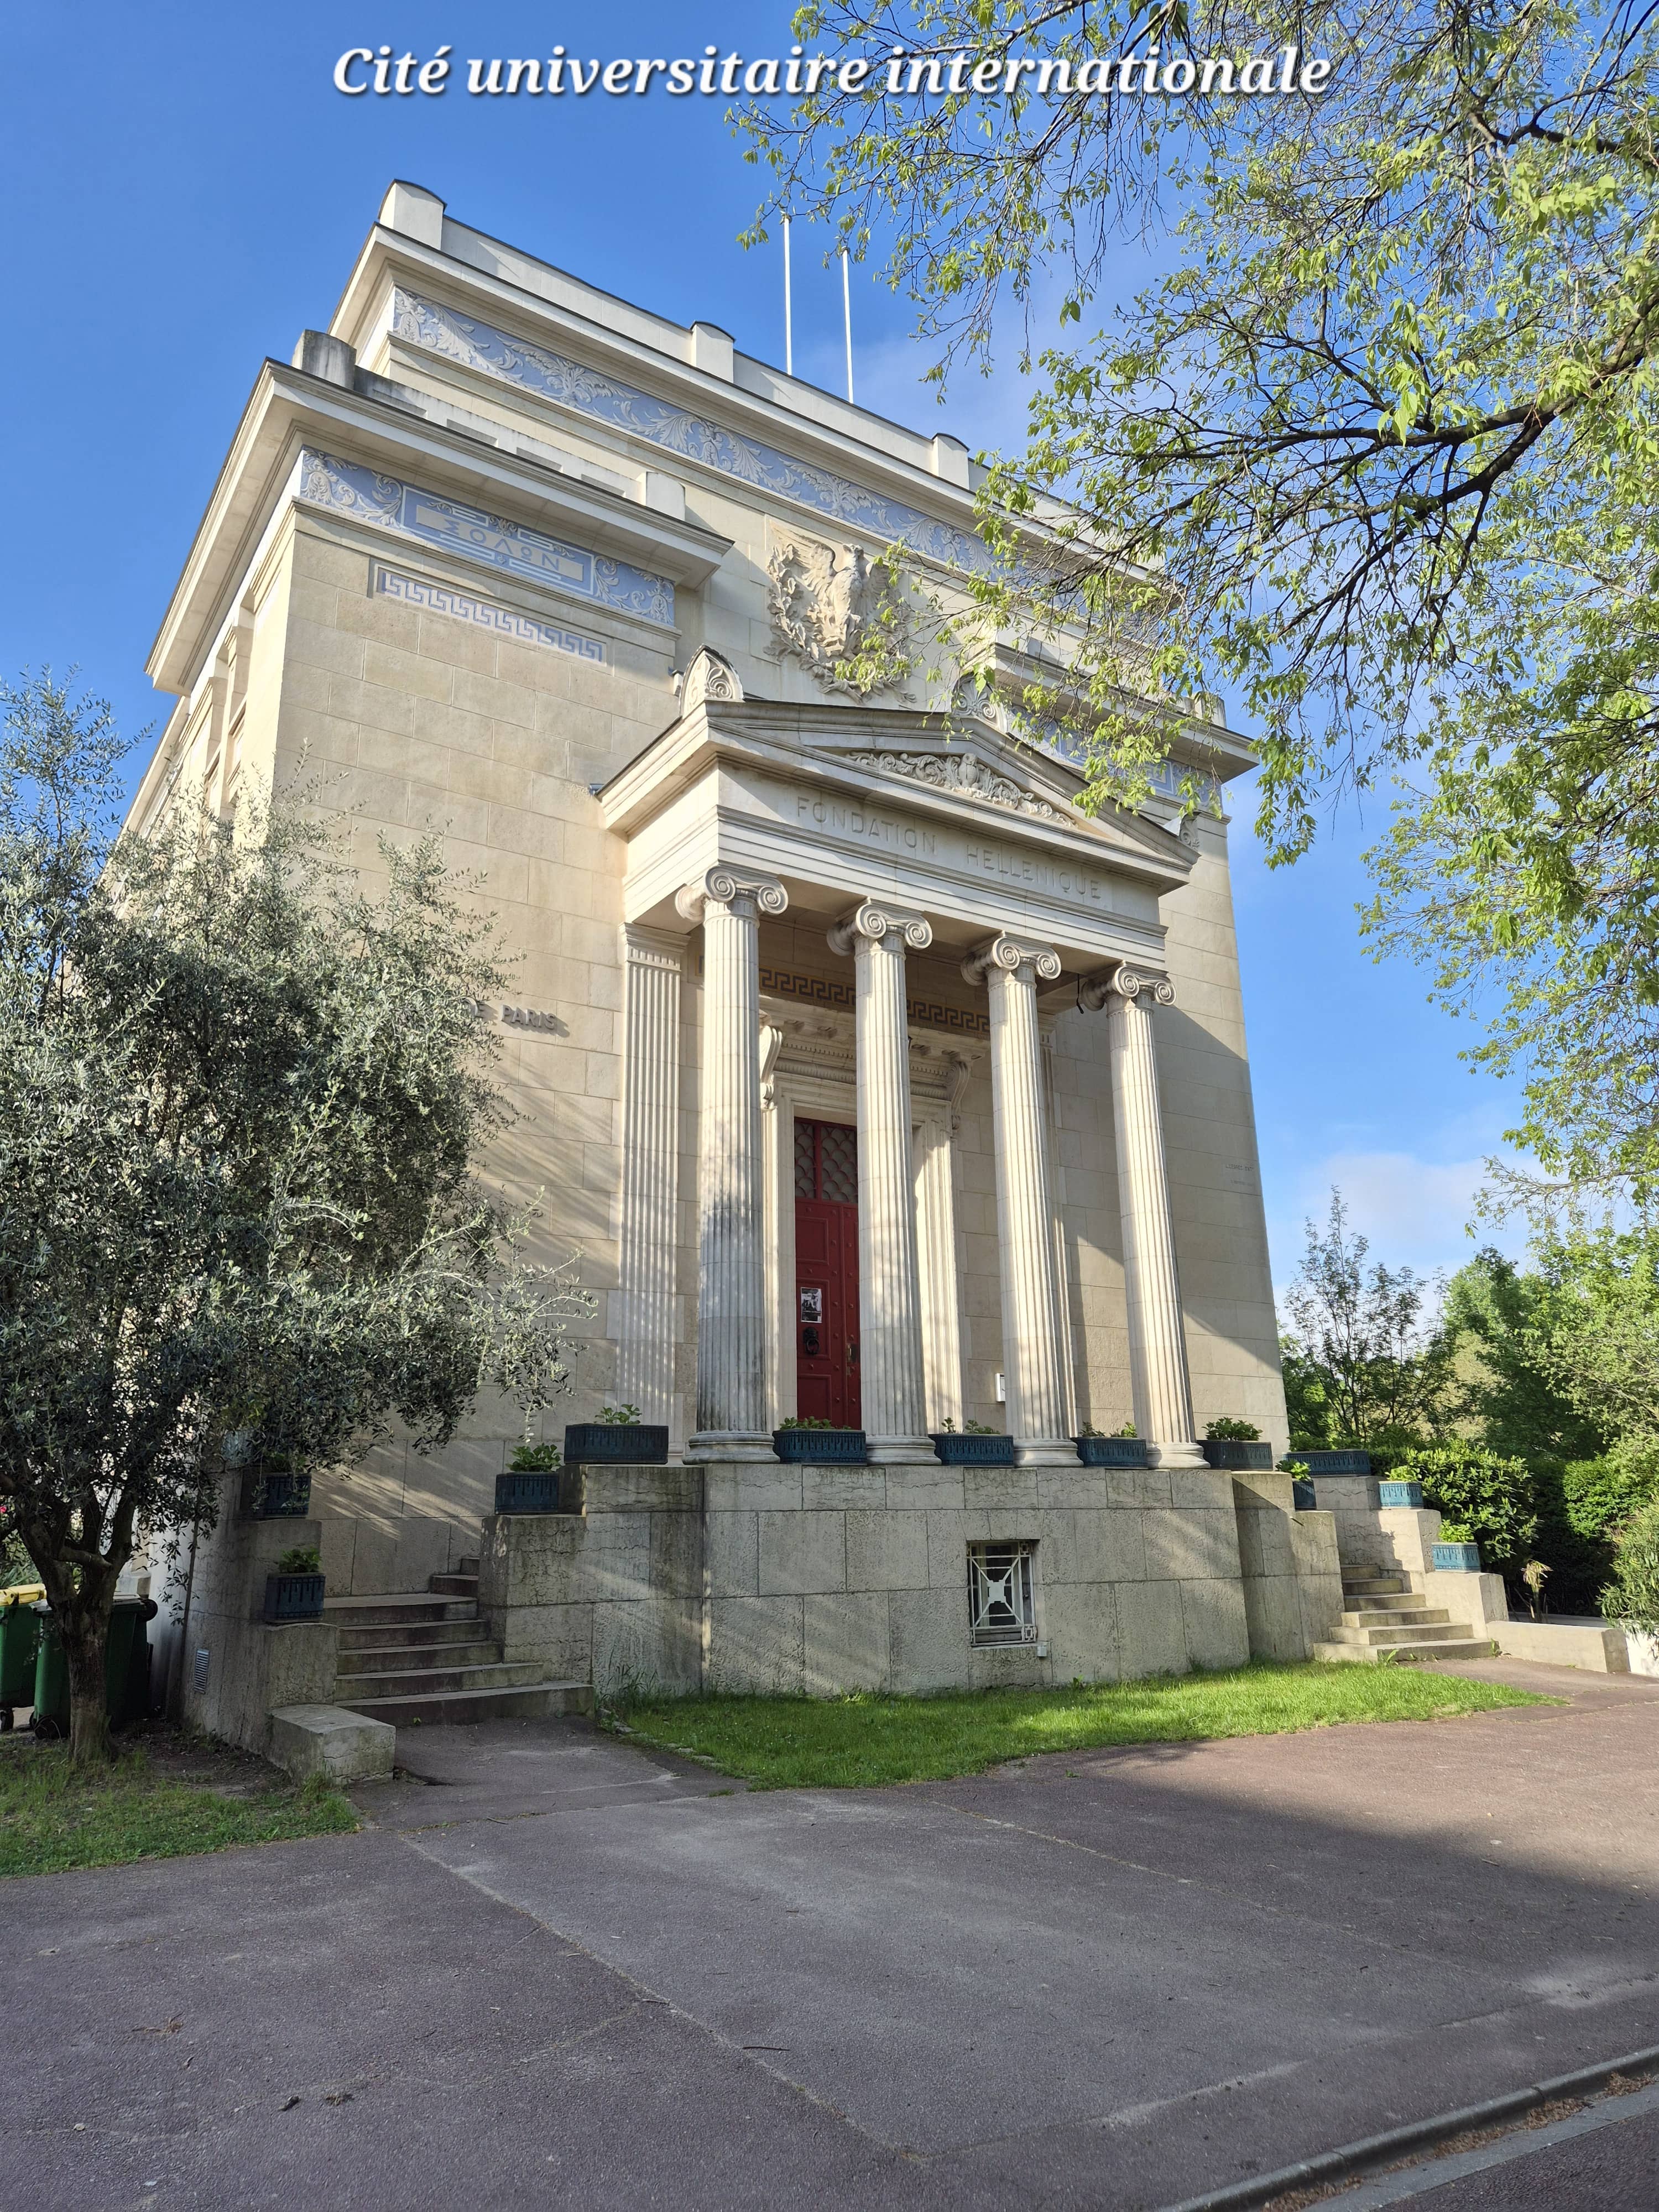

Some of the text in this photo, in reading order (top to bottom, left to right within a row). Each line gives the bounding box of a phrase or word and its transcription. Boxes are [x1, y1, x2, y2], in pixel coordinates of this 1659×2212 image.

[797, 796, 1102, 899] FONDATION HELLENIQUE
[501, 1004, 558, 1030] PARIS
